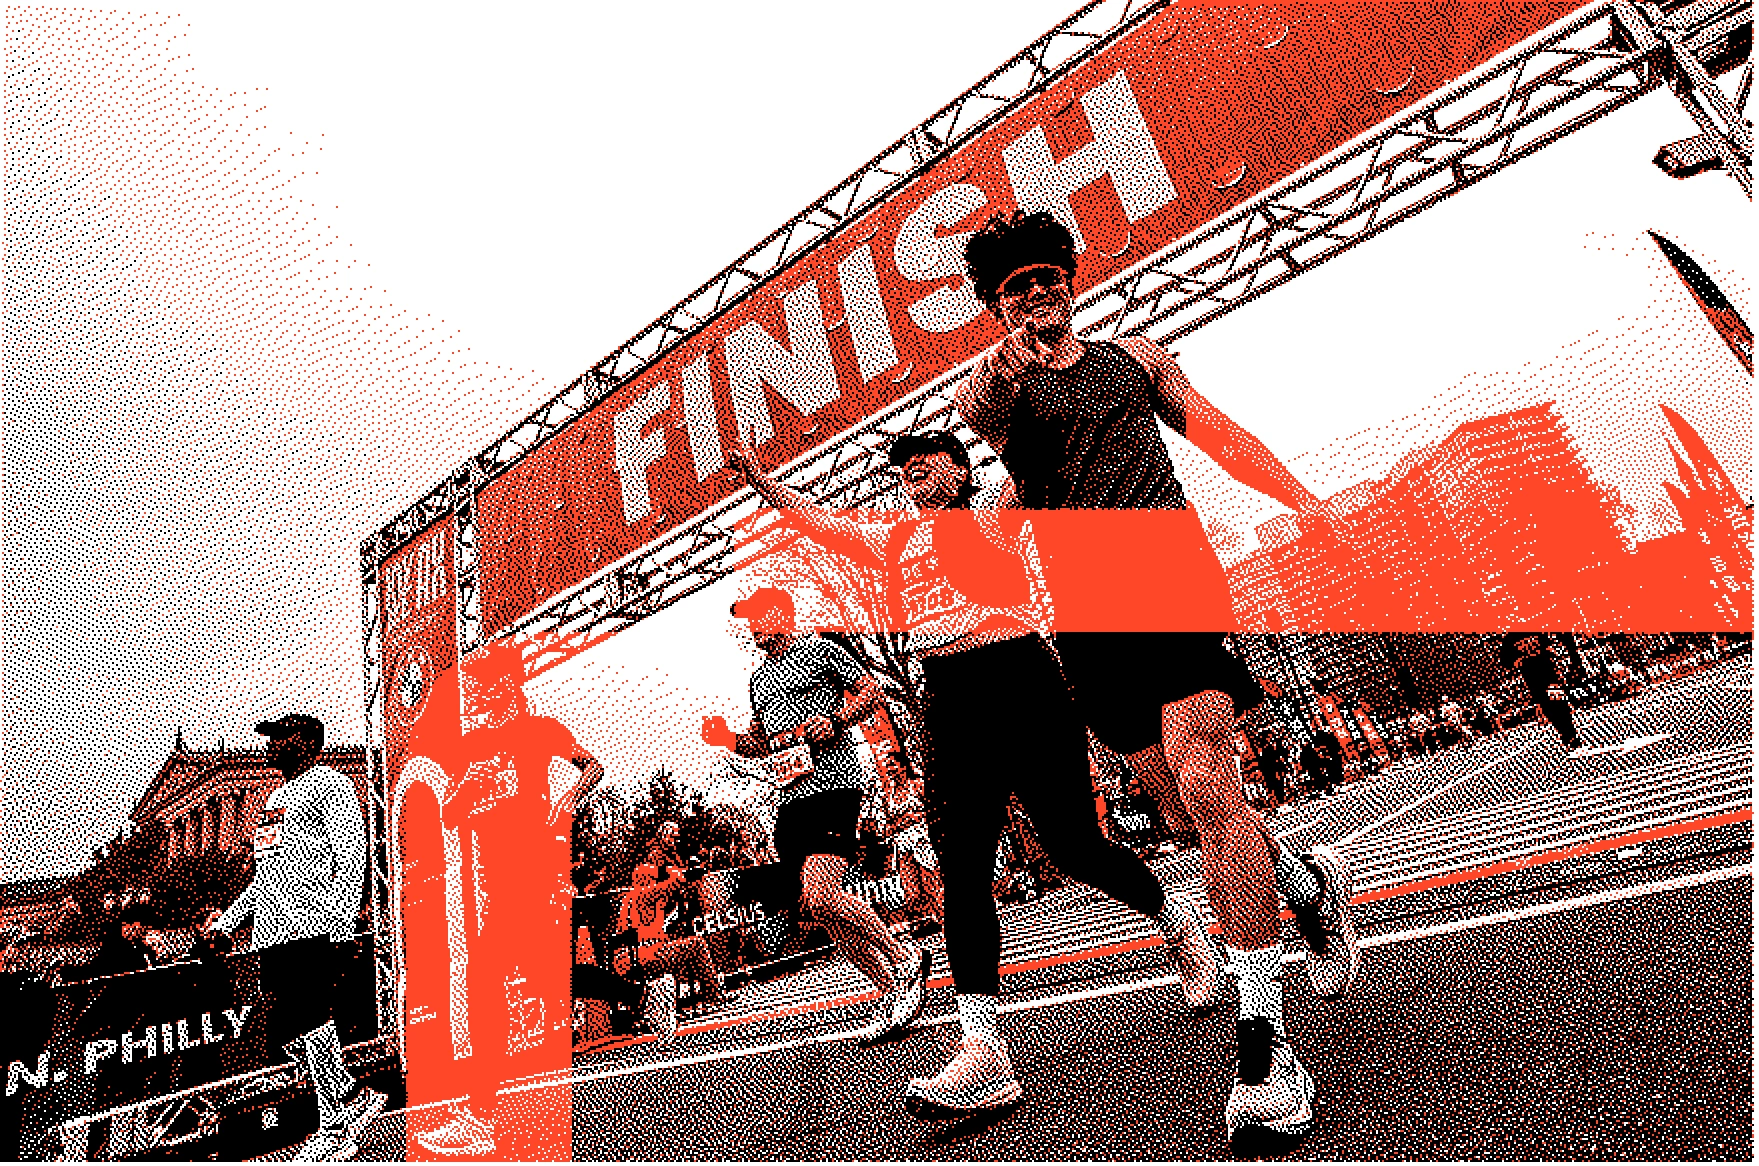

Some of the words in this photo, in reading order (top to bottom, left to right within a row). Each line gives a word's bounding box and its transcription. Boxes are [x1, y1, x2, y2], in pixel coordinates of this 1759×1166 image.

[612, 68, 1178, 526] FINISH
[693, 901, 766, 937] CELSIUS
[83, 1005, 253, 1076] PHILLY
